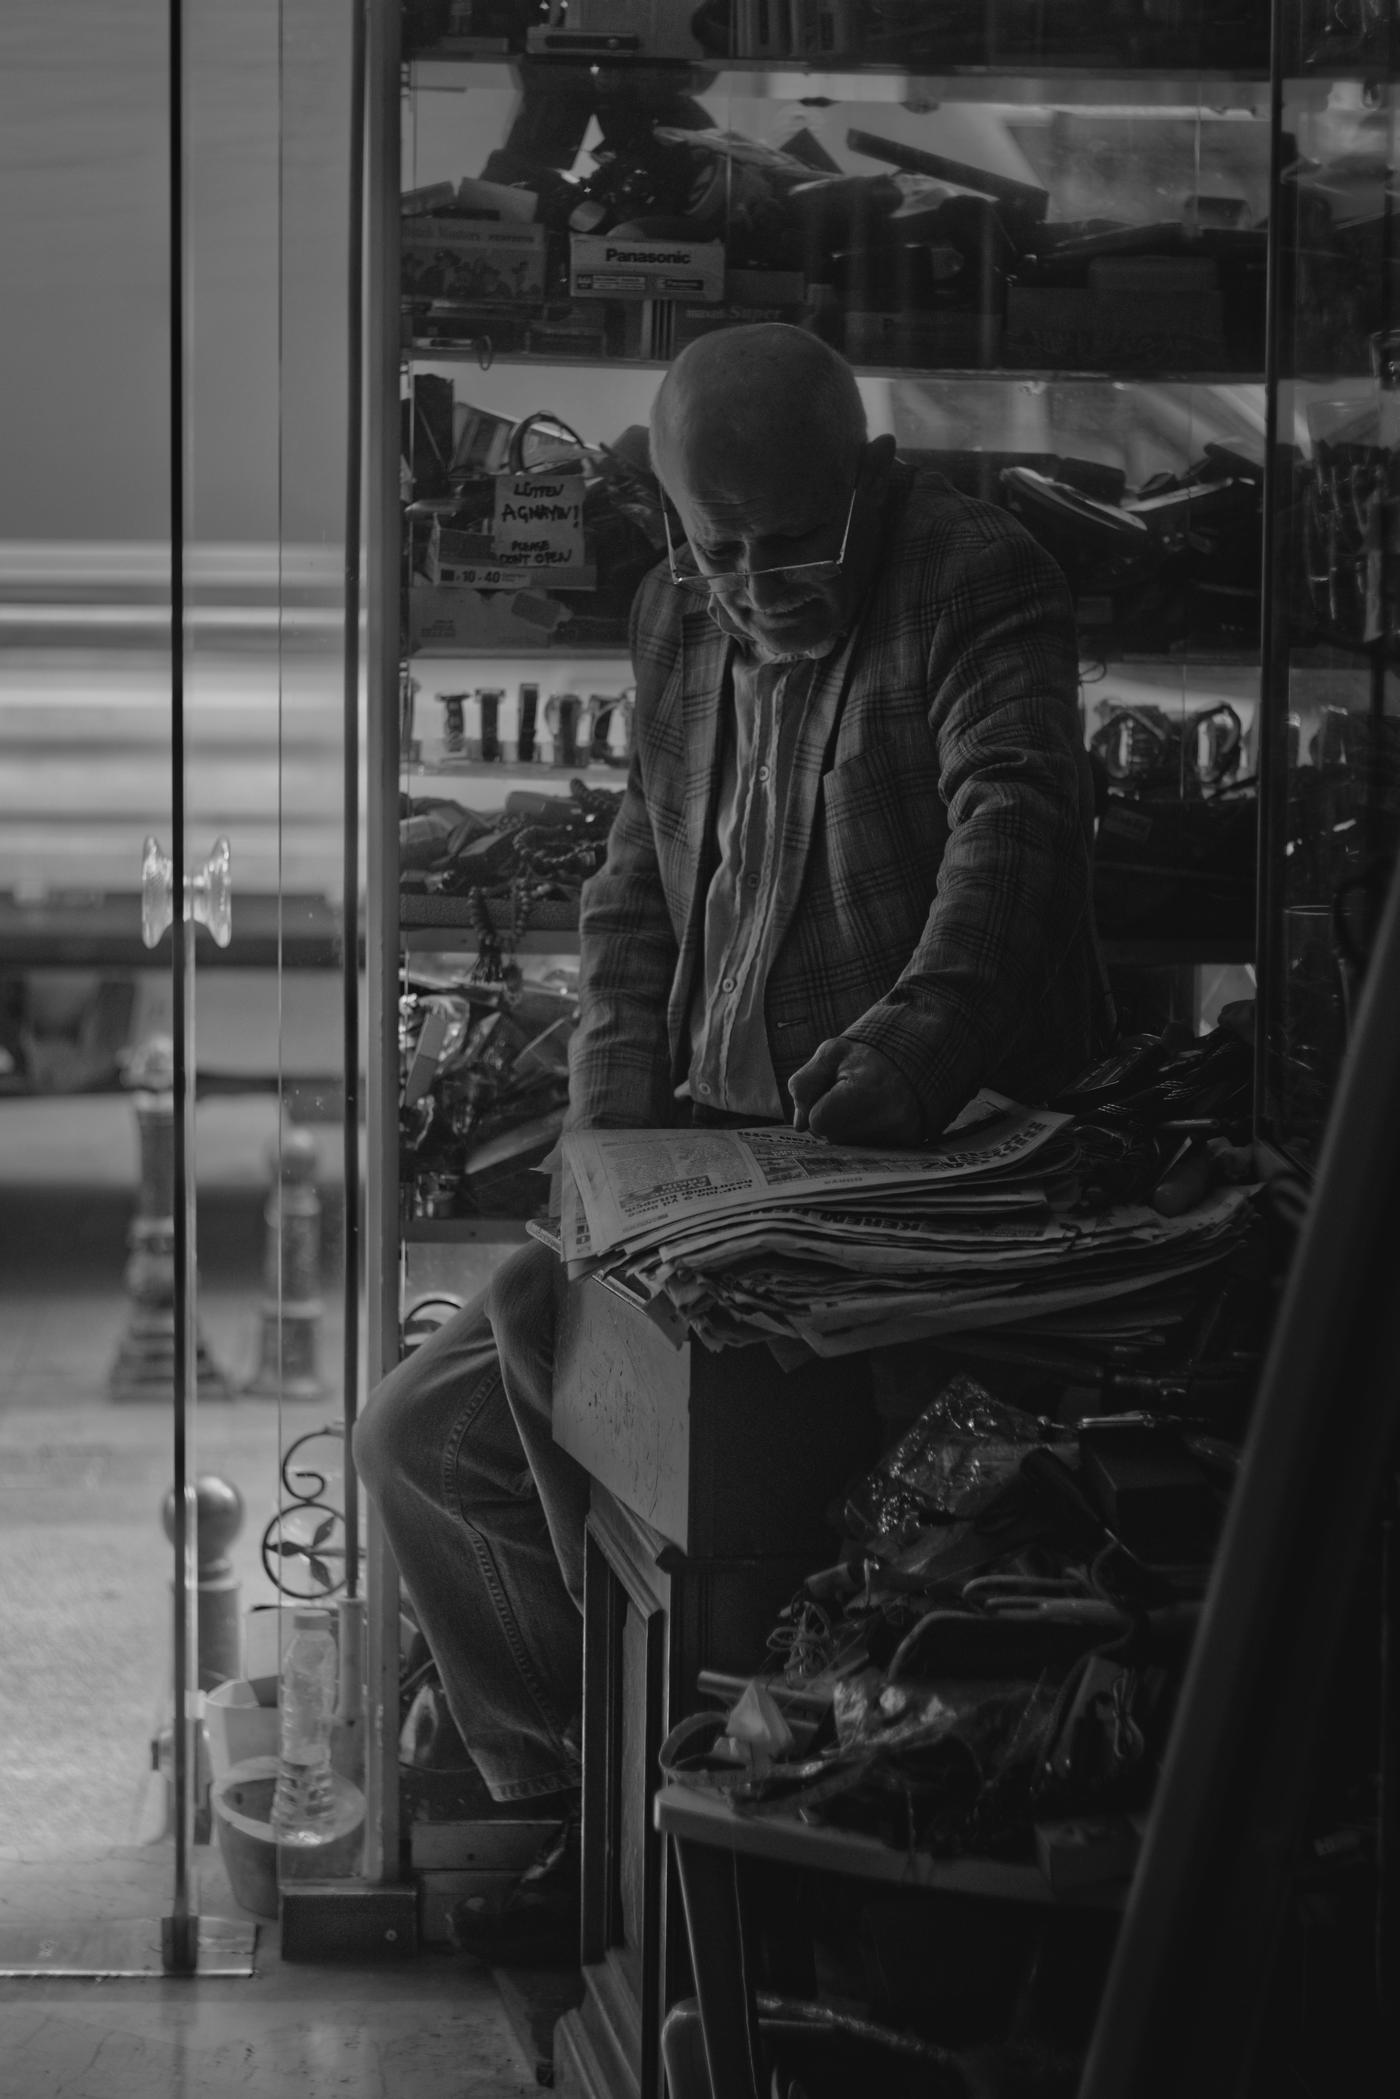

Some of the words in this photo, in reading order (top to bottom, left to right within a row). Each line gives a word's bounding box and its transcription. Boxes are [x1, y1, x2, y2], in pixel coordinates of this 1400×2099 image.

[605, 248, 691, 265] Panasonic
[534, 549, 572, 564] OPEN
[484, 571, 501, 583] 40
[819, 1214, 921, 1232] KEREM
